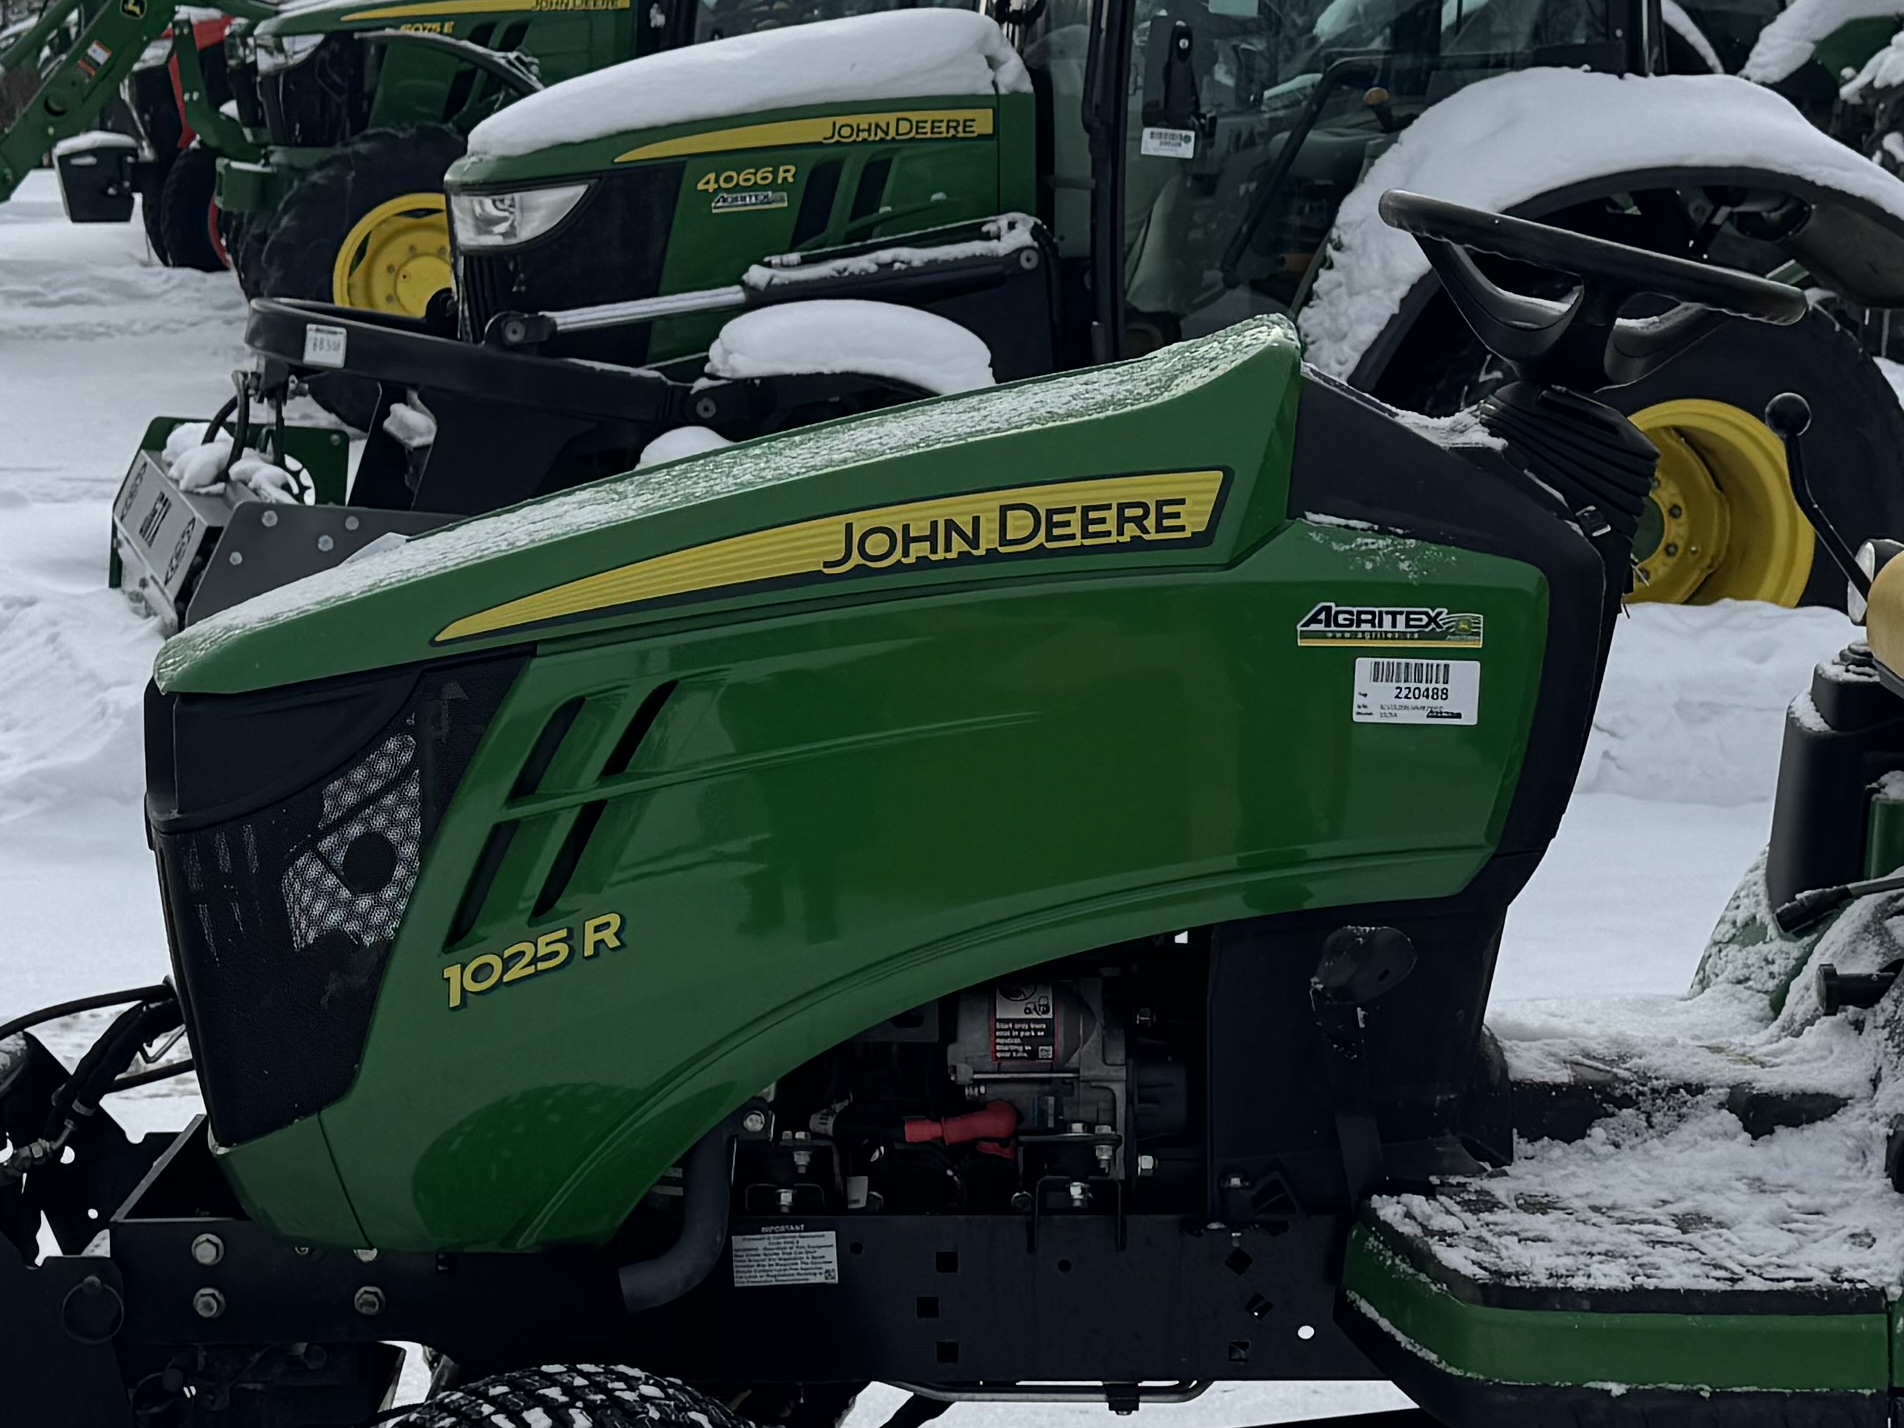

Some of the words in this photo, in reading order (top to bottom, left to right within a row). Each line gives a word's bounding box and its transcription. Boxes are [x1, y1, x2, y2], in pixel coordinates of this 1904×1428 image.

[822, 120, 891, 143] JOHN
[895, 117, 977, 138] DEERE
[696, 166, 774, 192] 4066
[777, 164, 797, 184] R
[822, 514, 983, 572] JOHN
[997, 498, 1188, 550] DEERE
[1300, 605, 1445, 630] AGRITEX
[1394, 686, 1449, 701] 220488
[442, 925, 570, 1008] 1025
[582, 912, 623, 958] R
